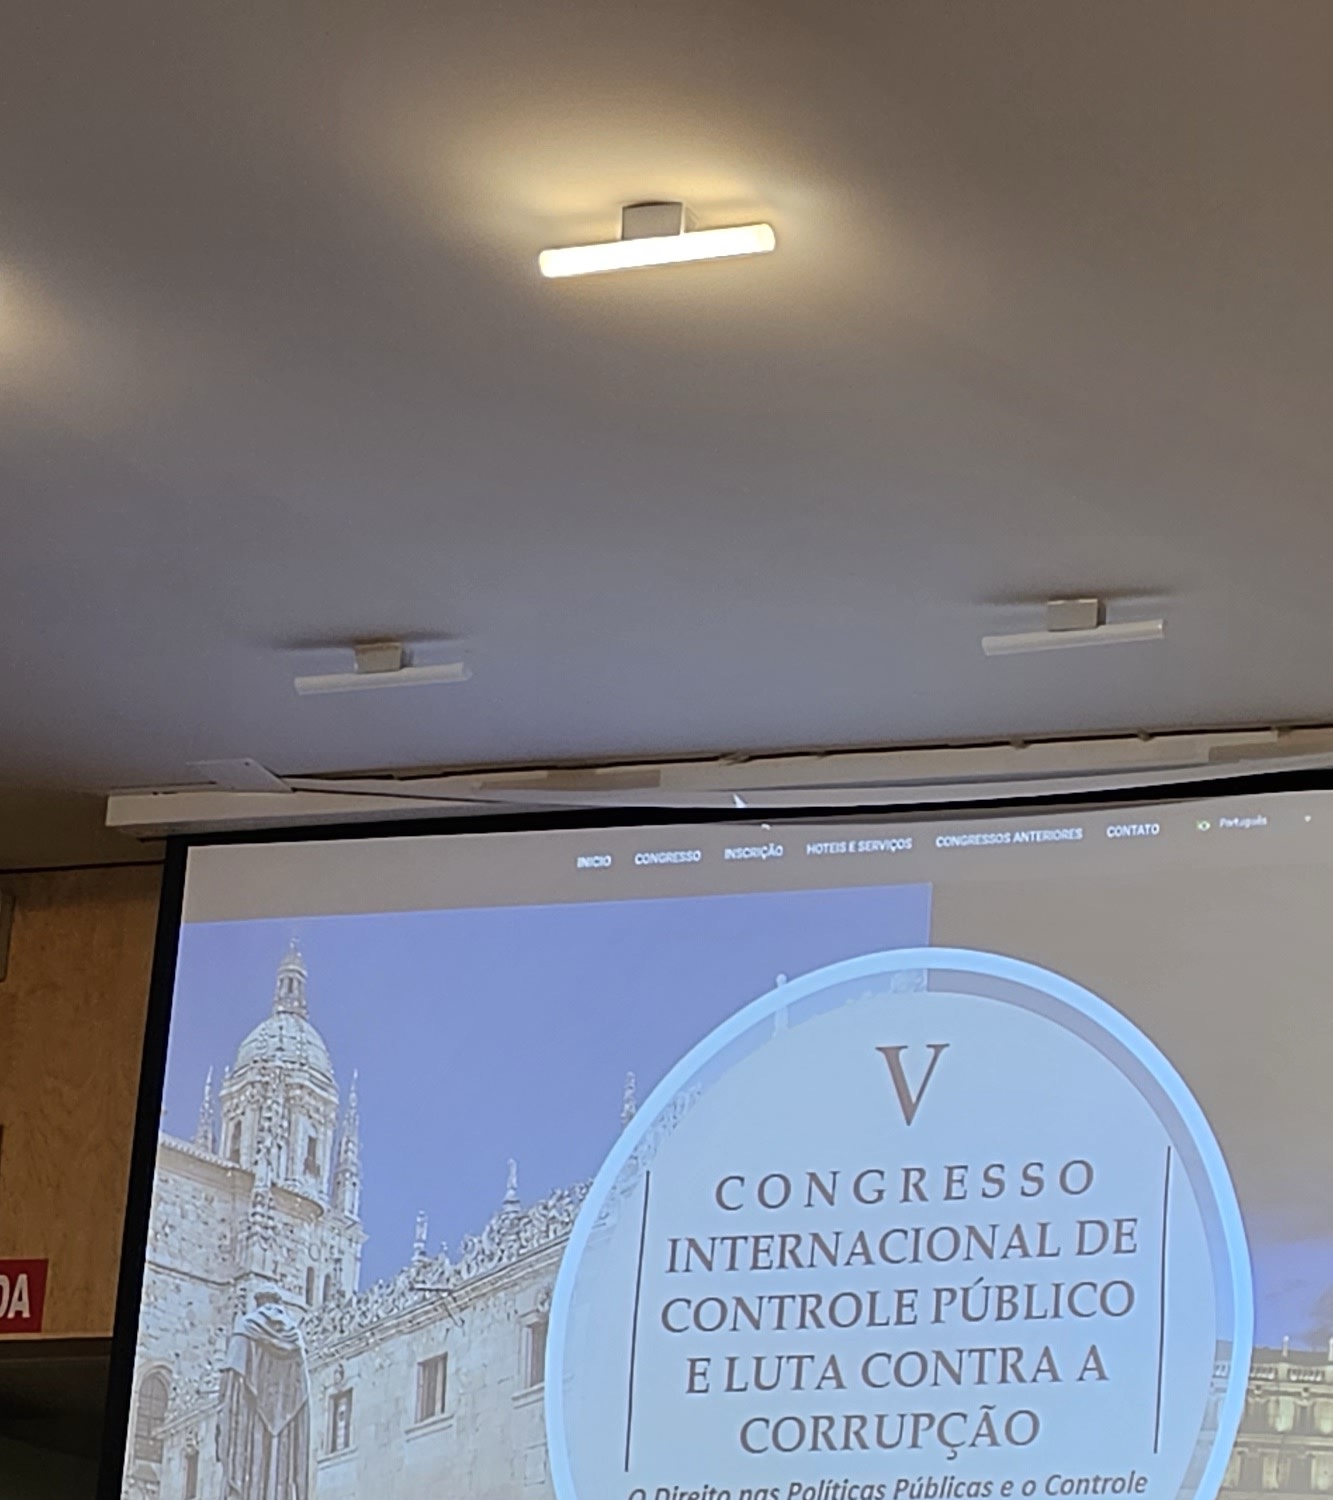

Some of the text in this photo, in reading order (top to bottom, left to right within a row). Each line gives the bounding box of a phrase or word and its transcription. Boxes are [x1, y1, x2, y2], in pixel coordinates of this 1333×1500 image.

[806, 841, 846, 855] HOTEIS
[858, 838, 912, 853] SERVIÇOS
[936, 828, 1083, 847] CONGRESSOS ANTERIORES
[1107, 823, 1159, 838] CONTATO
[635, 850, 701, 865] CONGRESSO
[724, 843, 783, 860] INSCRIÇÃO
[876, 1043, 950, 1126] V
[715, 1159, 1094, 1211] CONGRESSO
[665, 1218, 1138, 1273] INTERNACIONAL DE
[662, 1277, 1134, 1333] CONTROLE PÚBLICO
[686, 1344, 1109, 1394] E LUTA CONTRA A
[740, 1404, 1039, 1460] CORRUPÇÃO
[894, 1475, 993, 1500] Públicas
[1000, 1482, 1013, 1498] e
[1022, 1481, 1036, 1498] o
[1045, 1471, 1148, 1497] Controle
